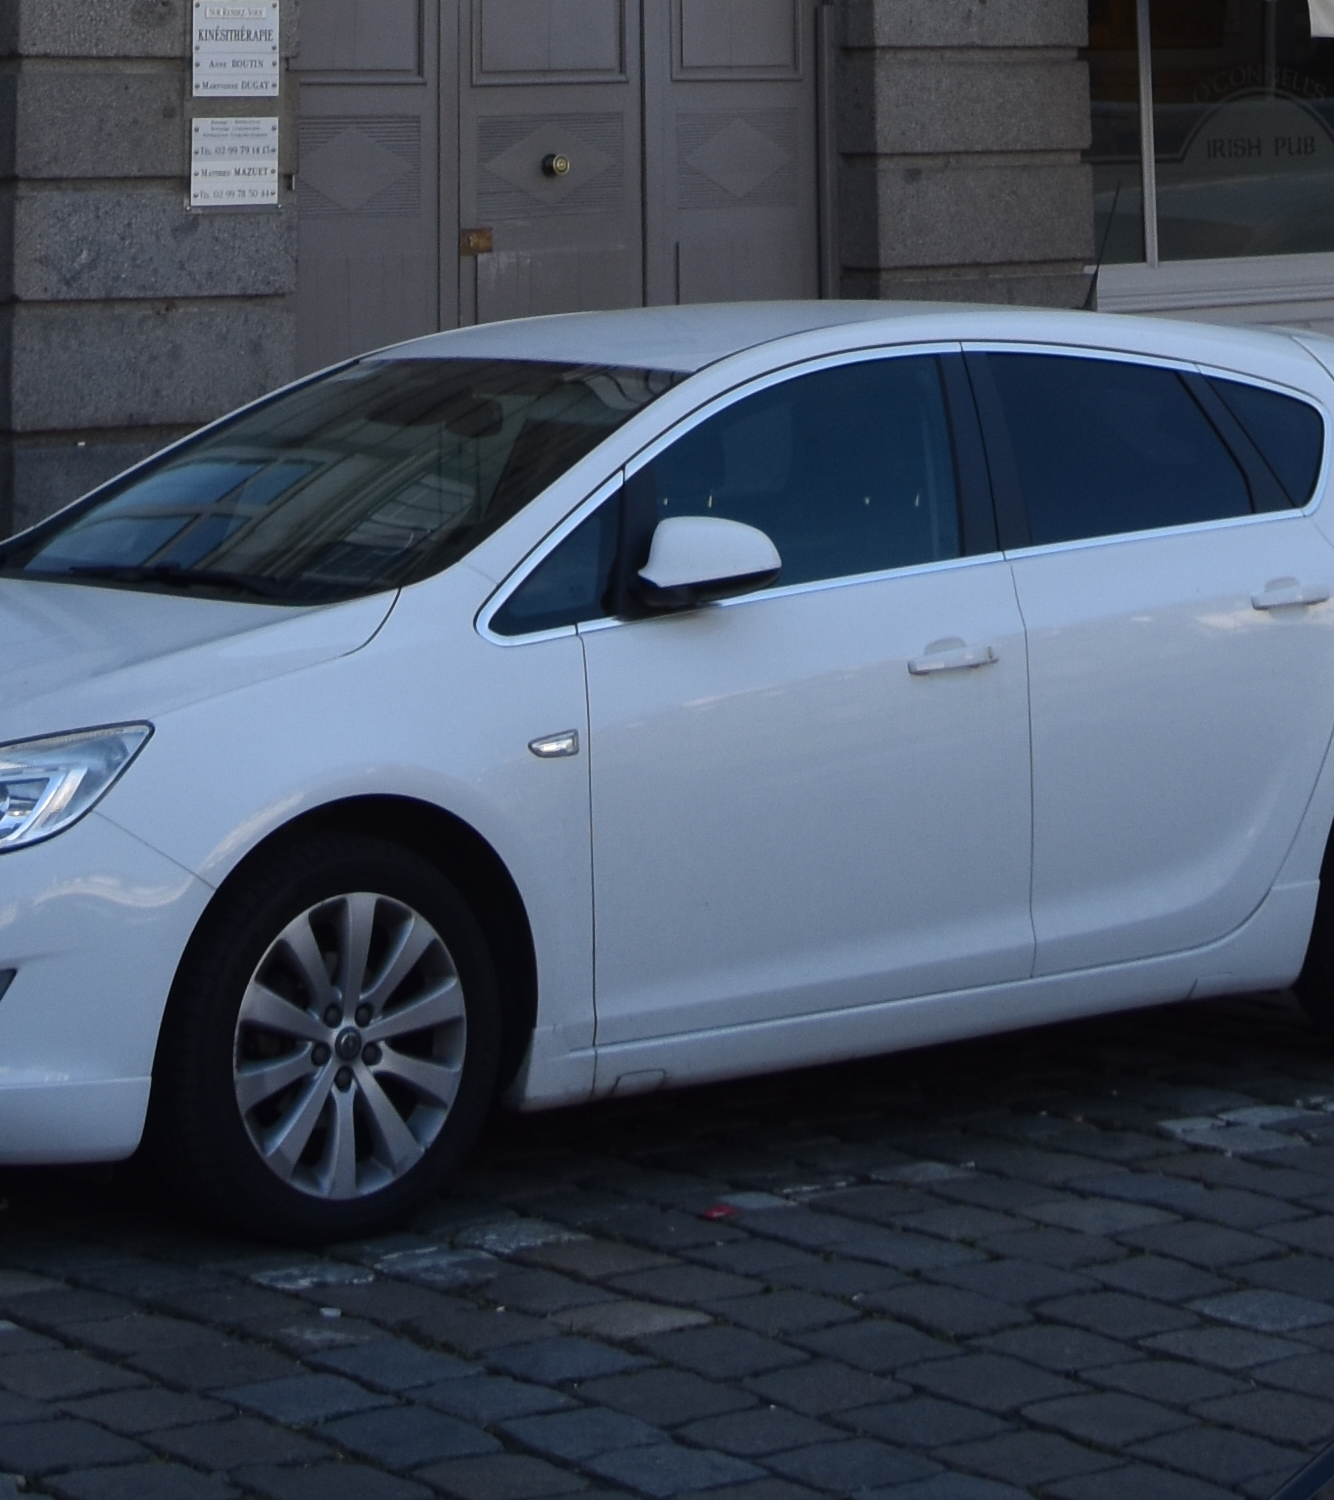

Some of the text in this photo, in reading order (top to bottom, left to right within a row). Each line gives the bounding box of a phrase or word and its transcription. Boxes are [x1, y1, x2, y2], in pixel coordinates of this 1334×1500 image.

[198, 25, 274, 42] KINÉSITHÉRAPIE
[232, 59, 264, 68] BOUTIN
[1207, 136, 1316, 159] IRISH PUB
